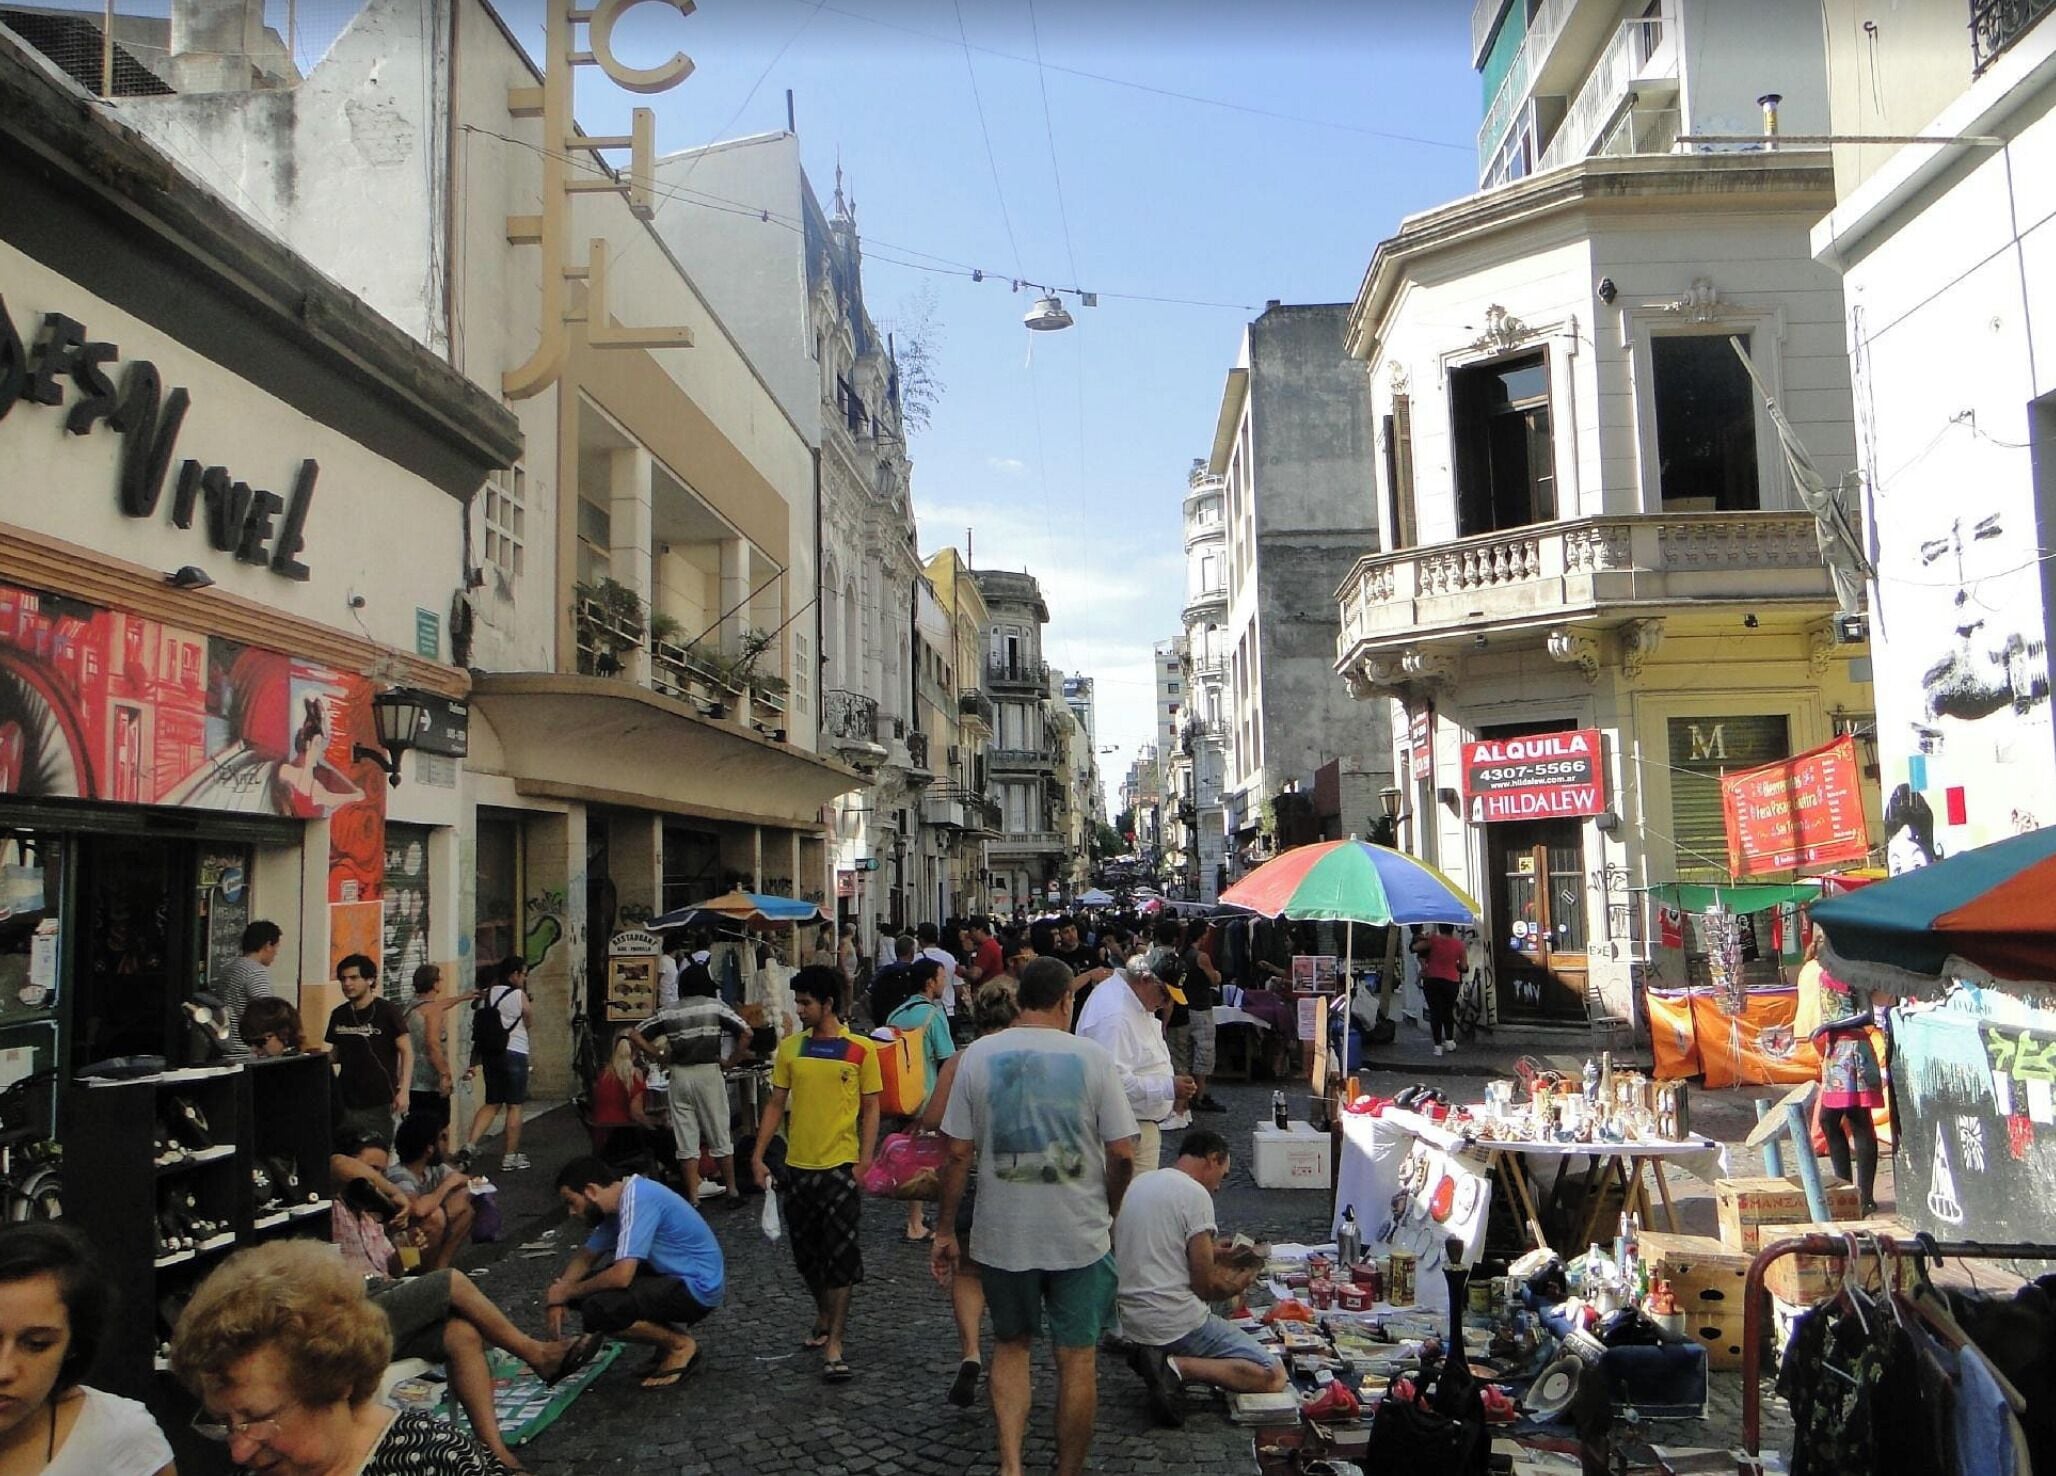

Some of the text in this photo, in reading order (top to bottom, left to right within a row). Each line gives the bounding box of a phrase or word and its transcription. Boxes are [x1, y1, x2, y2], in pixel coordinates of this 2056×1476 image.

[1473, 735, 1588, 763] ALQUILA
[1688, 724, 1726, 761] M
[1480, 760, 1586, 781] 4307-5566
[1490, 775, 1576, 789] www.hildalew.com.ar
[1750, 1197, 1834, 1210] MANZAS
